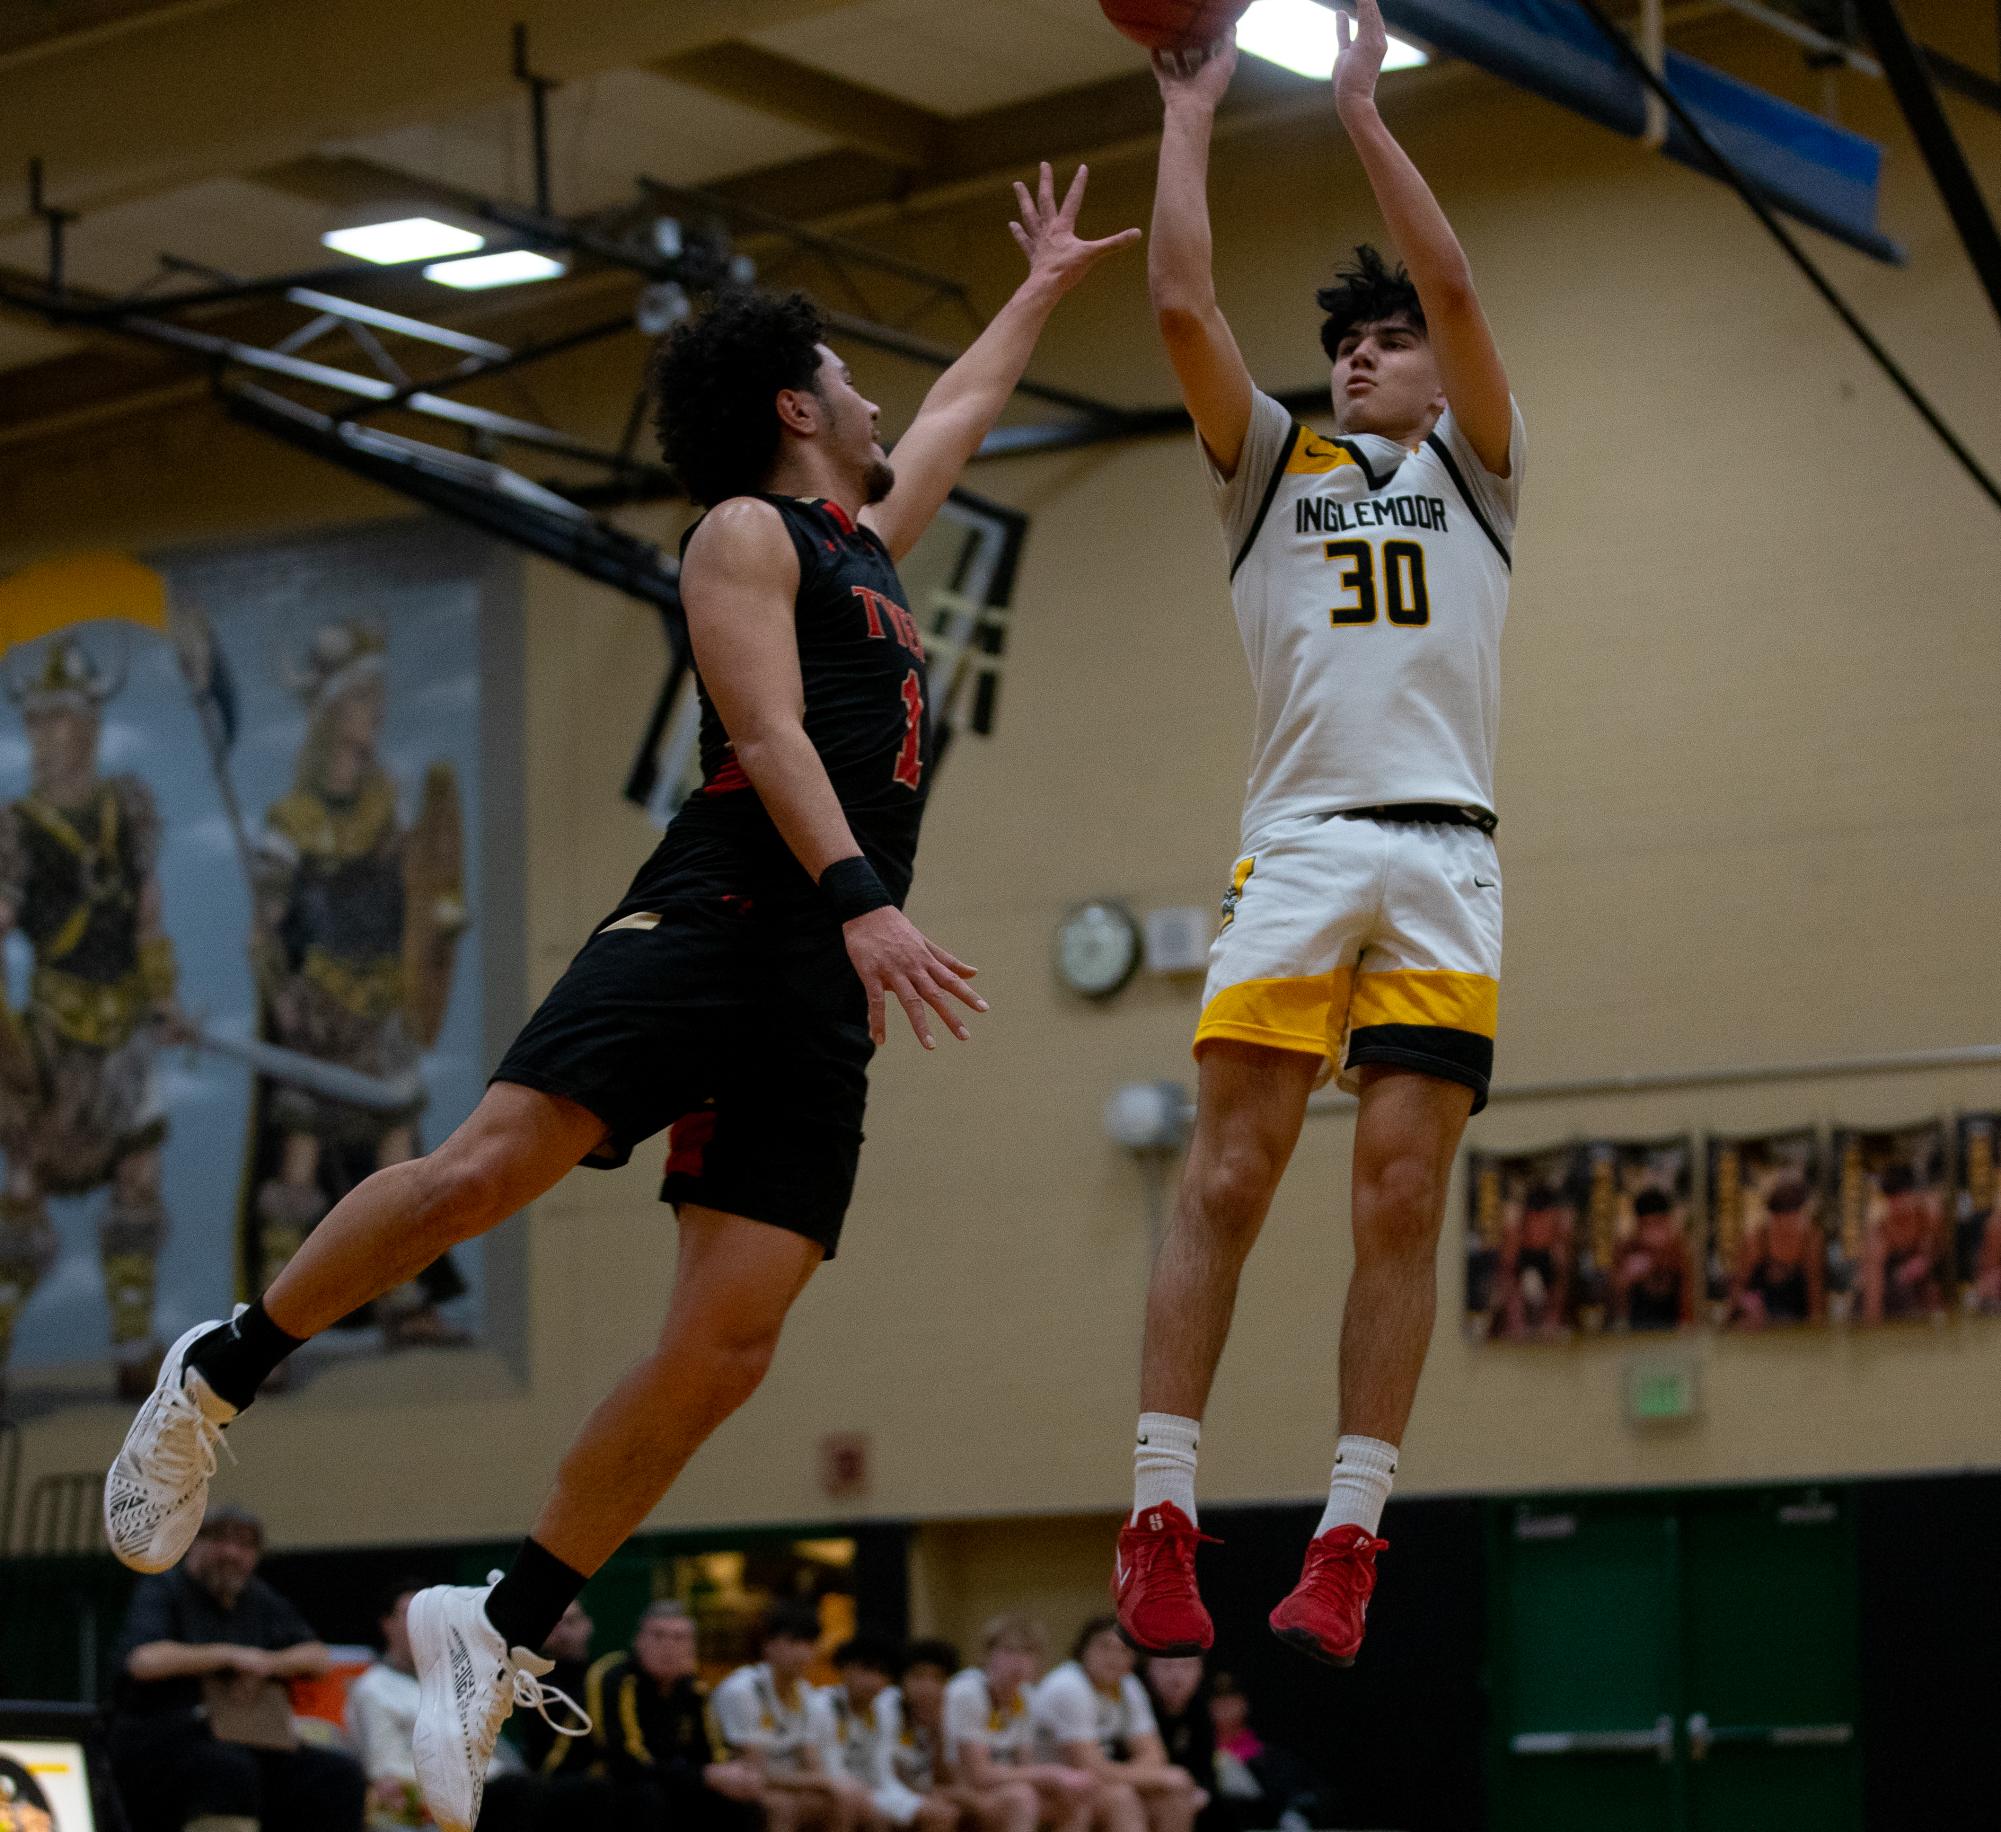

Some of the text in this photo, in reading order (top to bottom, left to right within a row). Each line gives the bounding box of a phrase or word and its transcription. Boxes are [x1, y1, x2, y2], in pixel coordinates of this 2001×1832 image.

[1296, 495, 1448, 533] INGLEMOOR
[1324, 538, 1430, 628] 30
[893, 668, 924, 791] 1
